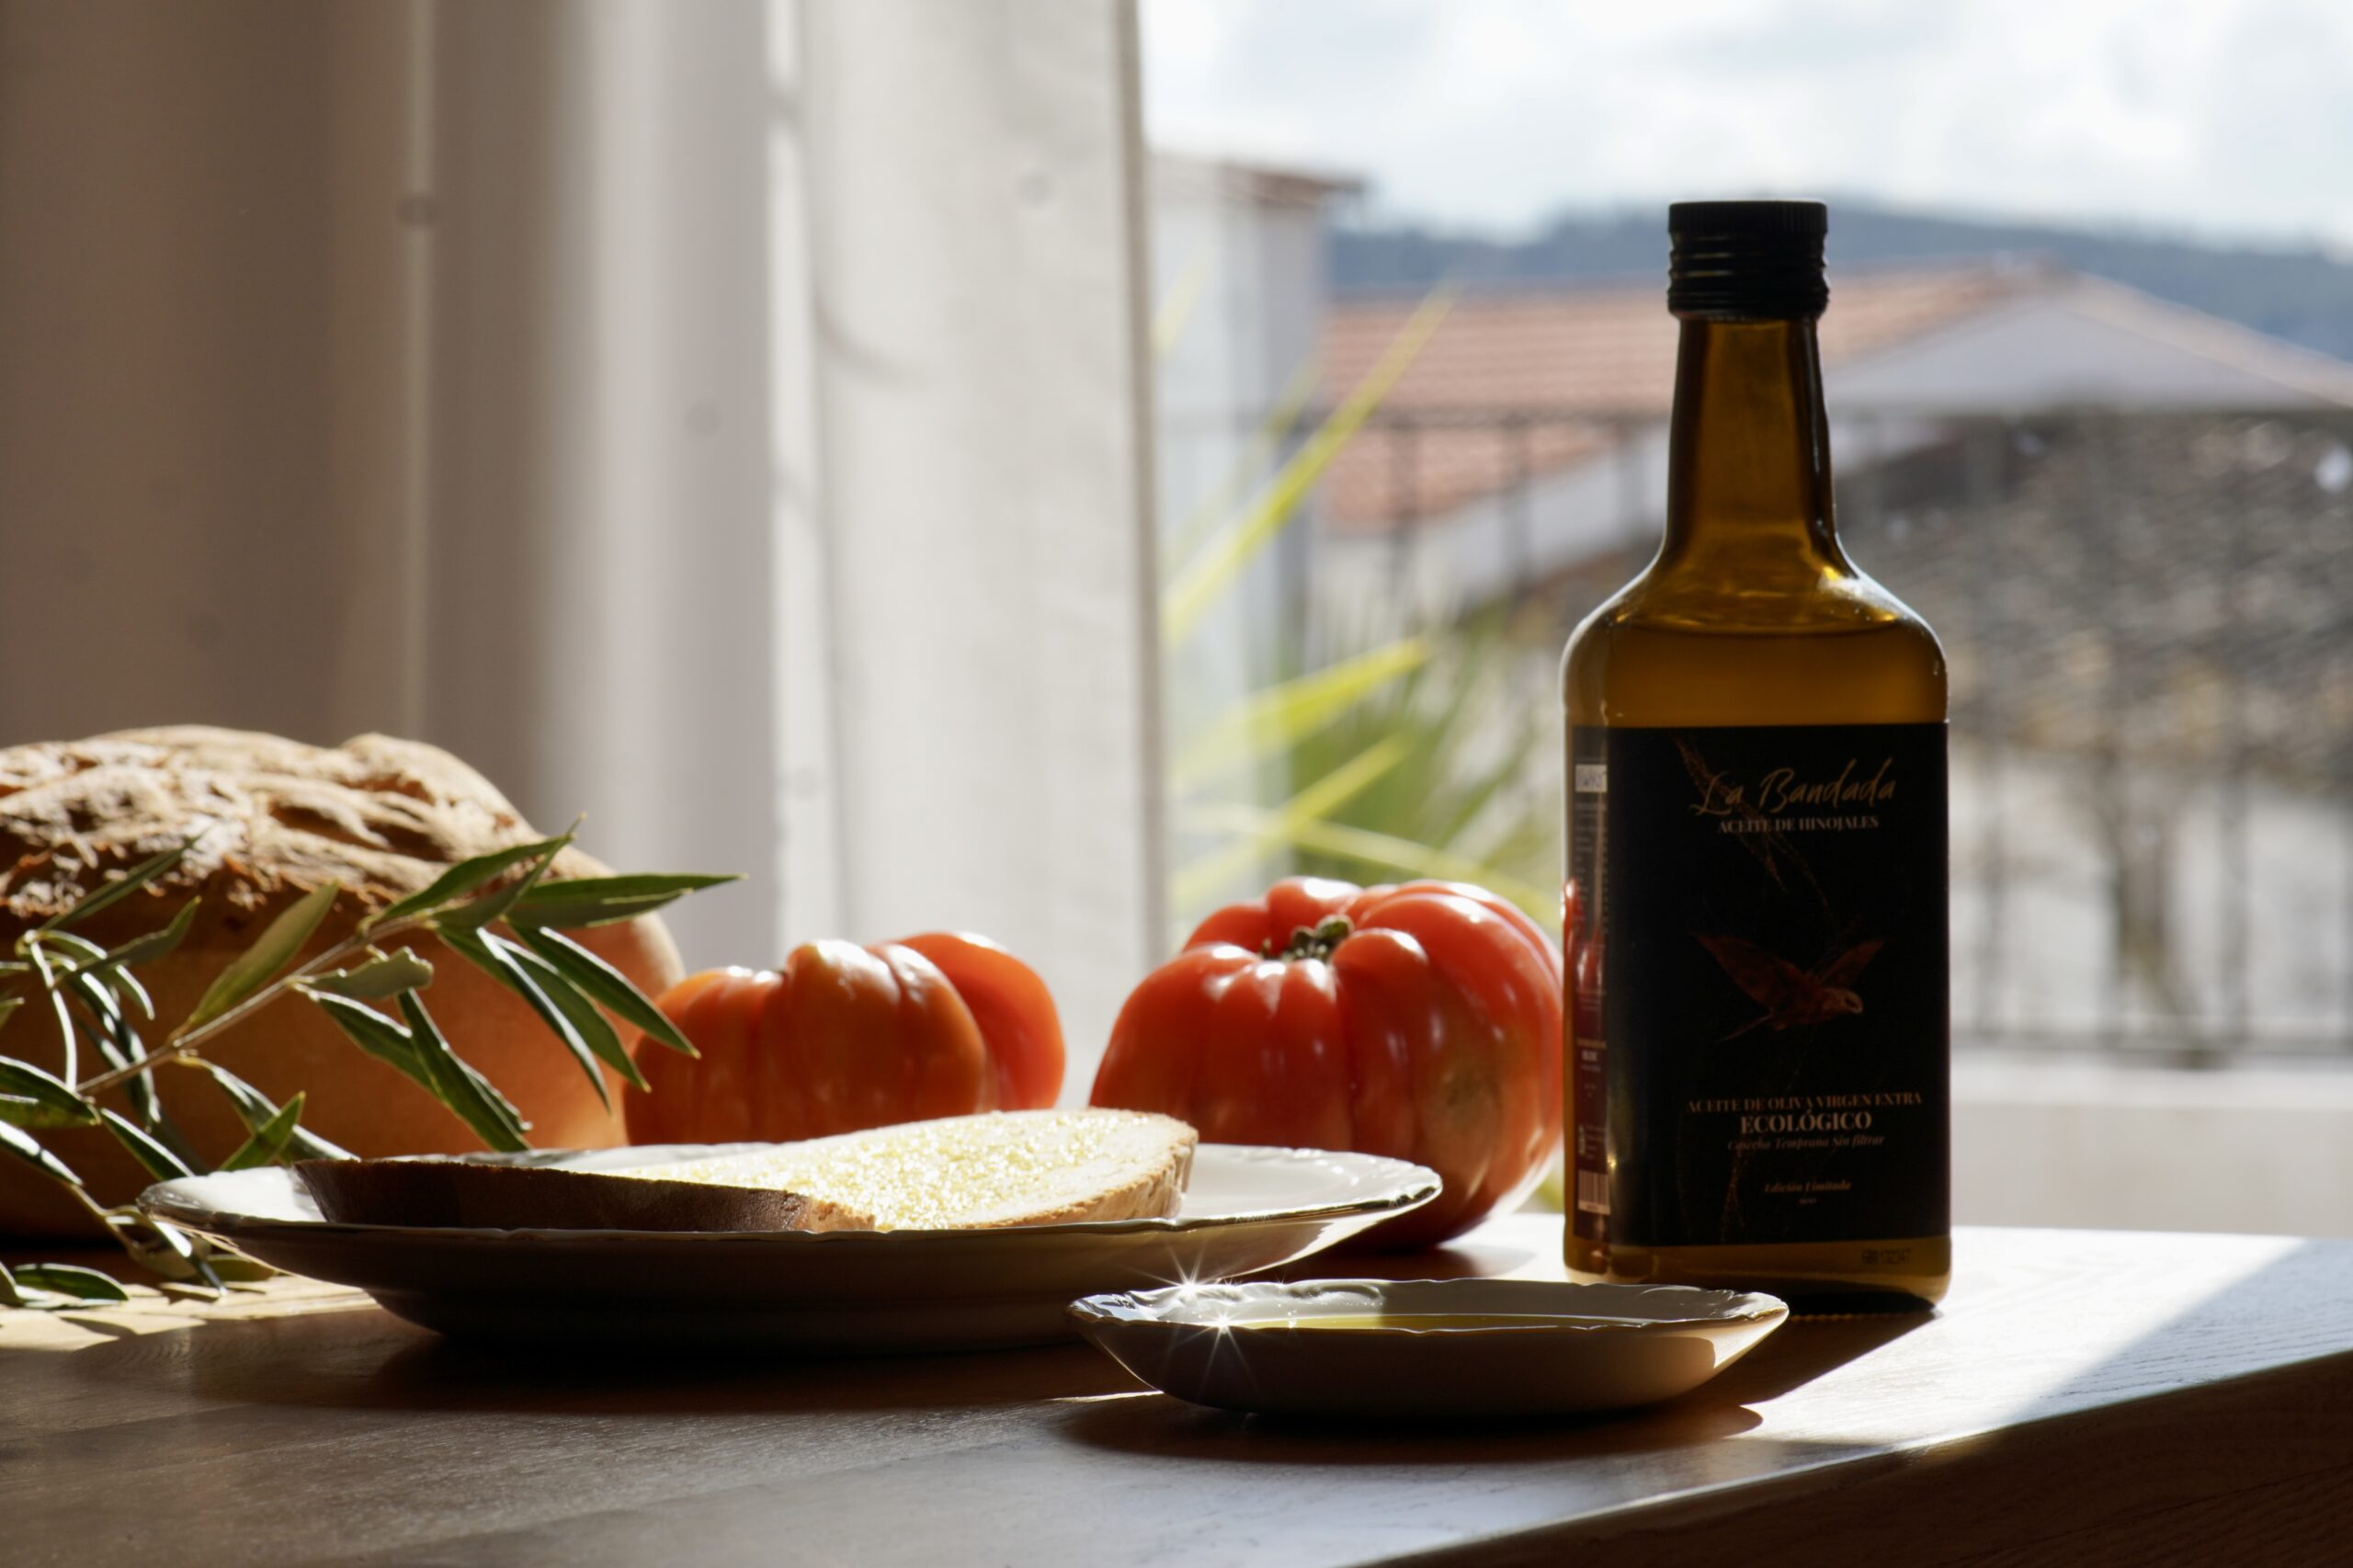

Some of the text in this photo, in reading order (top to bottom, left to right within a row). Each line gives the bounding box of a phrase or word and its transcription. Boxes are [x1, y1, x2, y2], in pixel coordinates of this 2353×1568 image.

[1689, 757, 1896, 816] La Bandada
[1718, 815, 1880, 834] ACEITE DE HINOJALES
[1688, 1092, 1923, 1113] ACEITE DE OLIVA VIRGEN EXTRA
[1740, 1108, 1872, 1134] ECOLÓGICO
